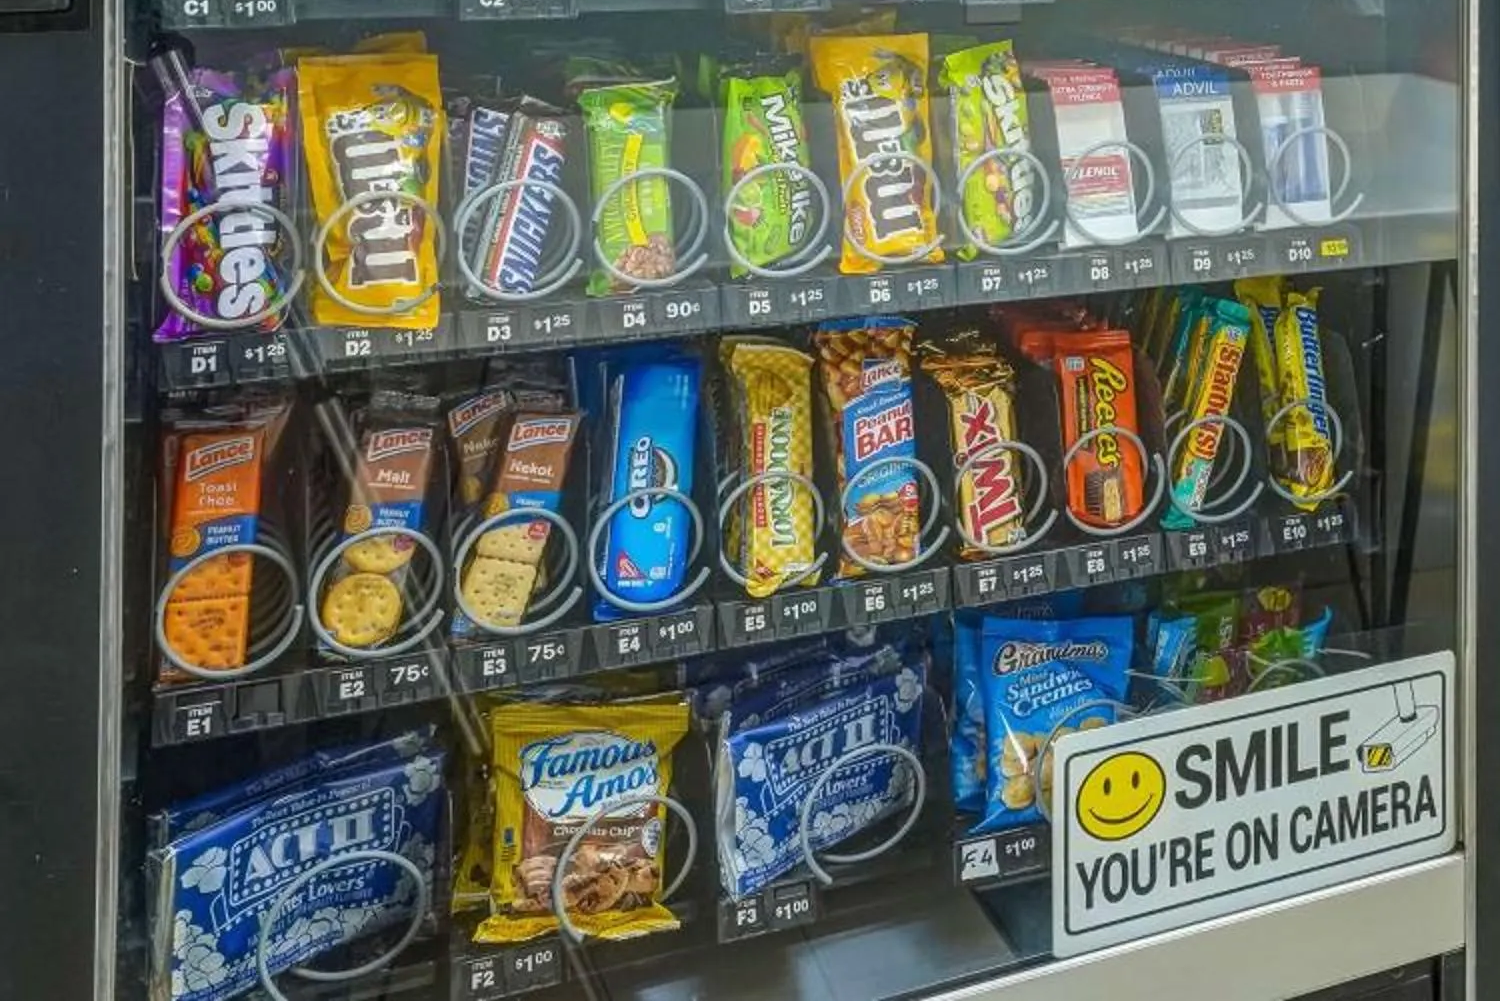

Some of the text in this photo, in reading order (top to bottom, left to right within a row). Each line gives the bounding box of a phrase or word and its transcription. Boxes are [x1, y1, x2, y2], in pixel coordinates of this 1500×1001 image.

[183, 0, 210, 16] C1
[1171, 80, 1217, 97] ADVIL
[500, 142, 566, 296] SNICKERS
[1193, 256, 1212, 271] D9
[982, 276, 1001, 290] D7
[870, 289, 891, 303] D6
[749, 300, 771, 314] D5
[623, 312, 647, 328] D4
[487, 326, 512, 341] D3
[345, 340, 372, 357] D2
[191, 356, 218, 374] D1
[1297, 307, 1328, 442] Butterfinger
[855, 402, 913, 433] Peanut
[371, 429, 432, 452] Lance
[512, 421, 569, 443] Lance
[856, 419, 914, 460] BAR
[189, 439, 251, 473] Lance
[376, 469, 411, 484] Malt
[630, 436, 651, 518] OREO
[765, 405, 796, 548] LORNA DOONE
[960, 401, 1021, 546] TWIX
[1283, 526, 1307, 540] E10
[1189, 542, 1207, 556] E9
[979, 577, 997, 593] E7
[865, 595, 886, 611] E6
[745, 615, 766, 631] E5
[618, 637, 641, 653] E4
[482, 659, 506, 676] E3
[339, 683, 365, 699] E2
[1013, 680, 1094, 718] Cremes
[186, 717, 212, 737] E1
[780, 713, 876, 777] ACT II
[521, 737, 657, 791] Famous
[1174, 709, 1351, 811] SMILE
[548, 763, 658, 818] Amos
[829, 775, 868, 798] Lovers
[243, 810, 376, 888] ACT II
[1075, 774, 1438, 911] YOU'RE ON CAMERA
[308, 875, 366, 902] Lovers
[736, 909, 758, 925] F3
[471, 971, 496, 989] F2
